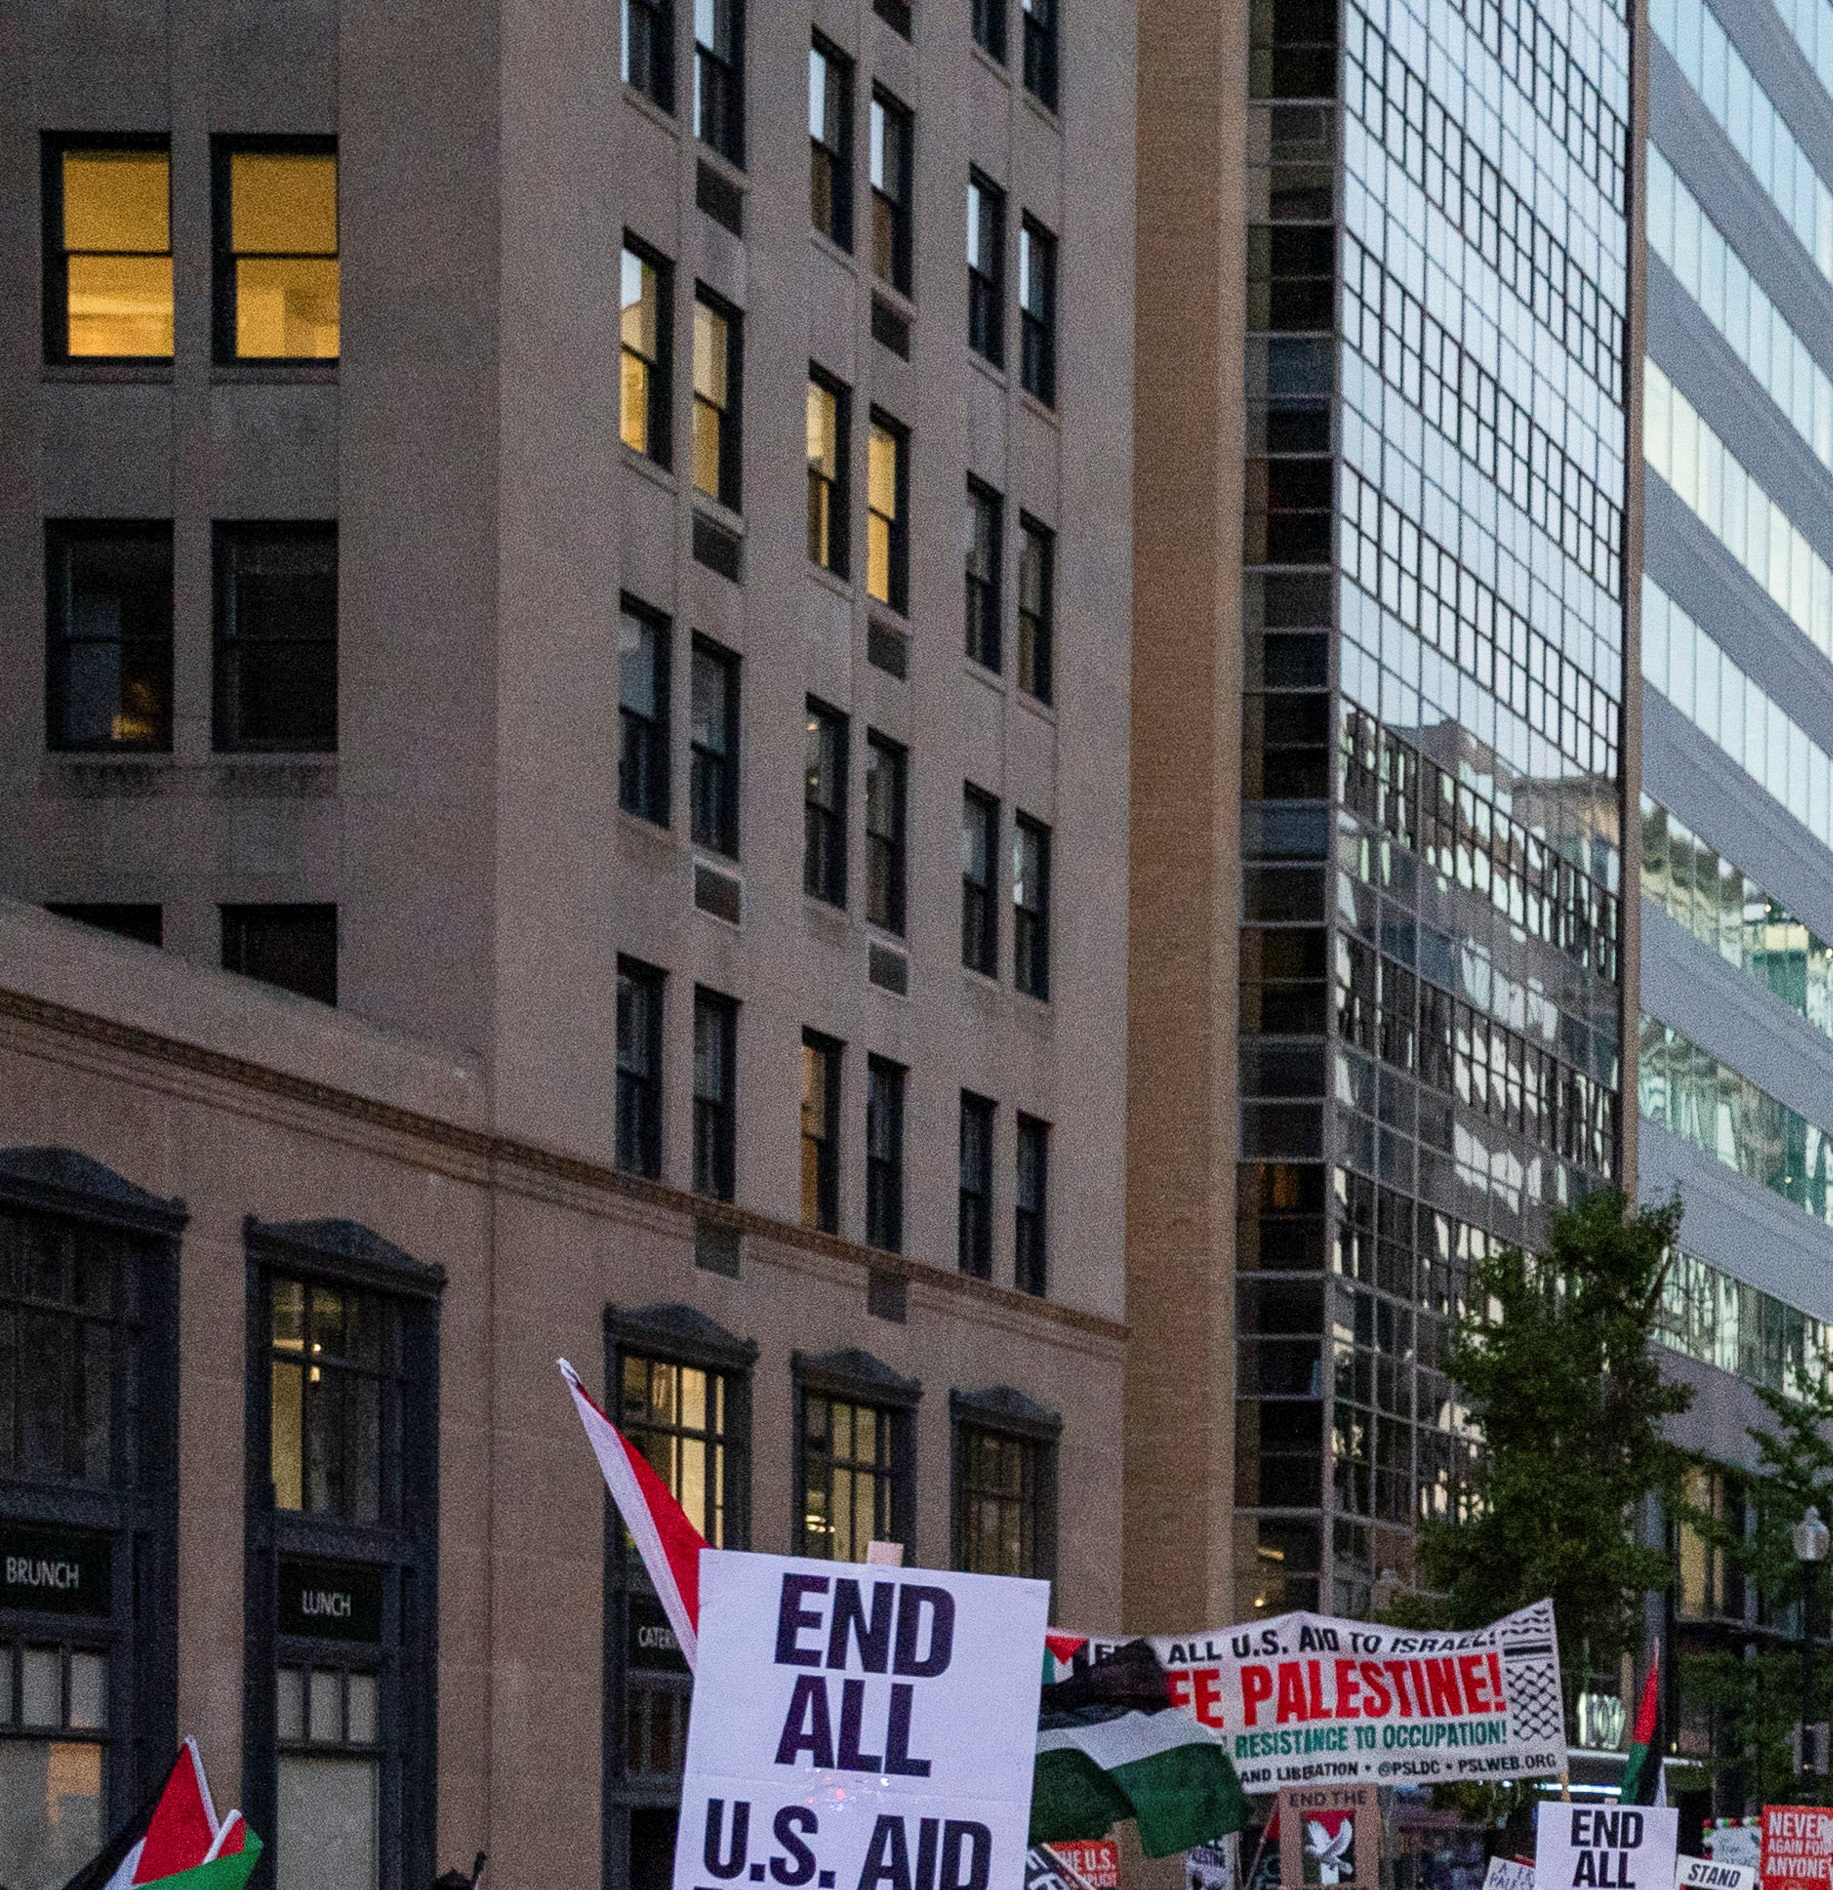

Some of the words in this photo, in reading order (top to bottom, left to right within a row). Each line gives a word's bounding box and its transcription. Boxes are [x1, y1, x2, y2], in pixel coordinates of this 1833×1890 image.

[6, 1557, 79, 1588] BRUNCH
[302, 1591, 351, 1616] LUNCH
[775, 1573, 956, 1678] END
[1168, 1641, 1222, 1663] ALL
[1232, 1629, 1289, 1658] U.S.
[1299, 1625, 1339, 1653] AID
[1350, 1632, 1382, 1654] TO
[1391, 1630, 1496, 1653] ISRAEL!
[1240, 1653, 1507, 1727] PALESTINE!
[775, 1674, 931, 1778] ALL
[1235, 1724, 1348, 1759] RESISTANCE
[1354, 1725, 1376, 1750] TO
[1383, 1720, 1507, 1749] OCCUPATION!
[1240, 1768, 1273, 1784] AND
[1277, 1761, 1358, 1782] LIBERATION
[1378, 1760, 1440, 1777] @PSLDC
[1458, 1754, 1556, 1774] PSLWEB.ORG
[1336, 1789, 1367, 1806] THE
[1570, 1809, 1644, 1849] END
[1769, 1811, 1829, 1838] NEVER
[703, 1798, 837, 1890] U.S.
[1572, 1850, 1635, 1889] ALL
[1688, 1864, 1741, 1888] STAND
[1766, 1857, 1828, 1879] ANYONE
